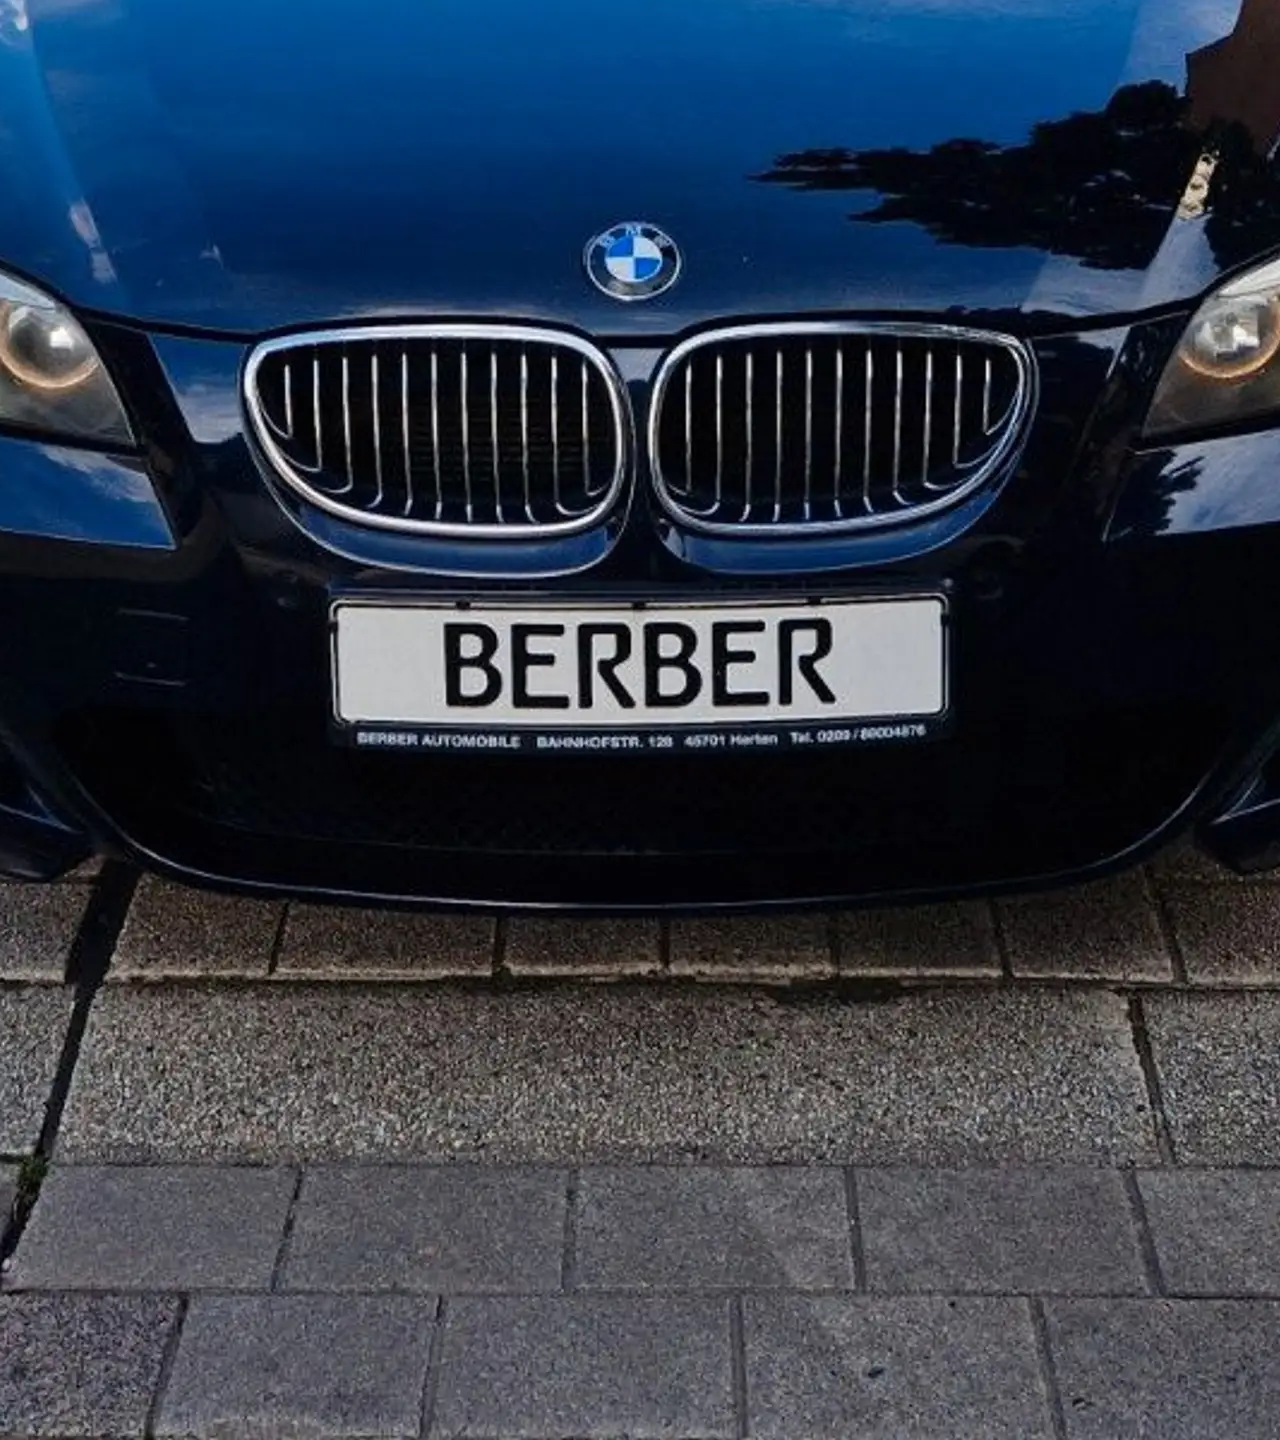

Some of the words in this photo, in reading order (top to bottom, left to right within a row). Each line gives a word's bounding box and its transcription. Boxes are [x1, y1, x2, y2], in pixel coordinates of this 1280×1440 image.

[443, 617, 837, 709] BERBER
[356, 731, 419, 747] BERBER
[421, 733, 521, 749] AUTOMOBILE
[536, 735, 644, 749] BAHNHOFSTR.
